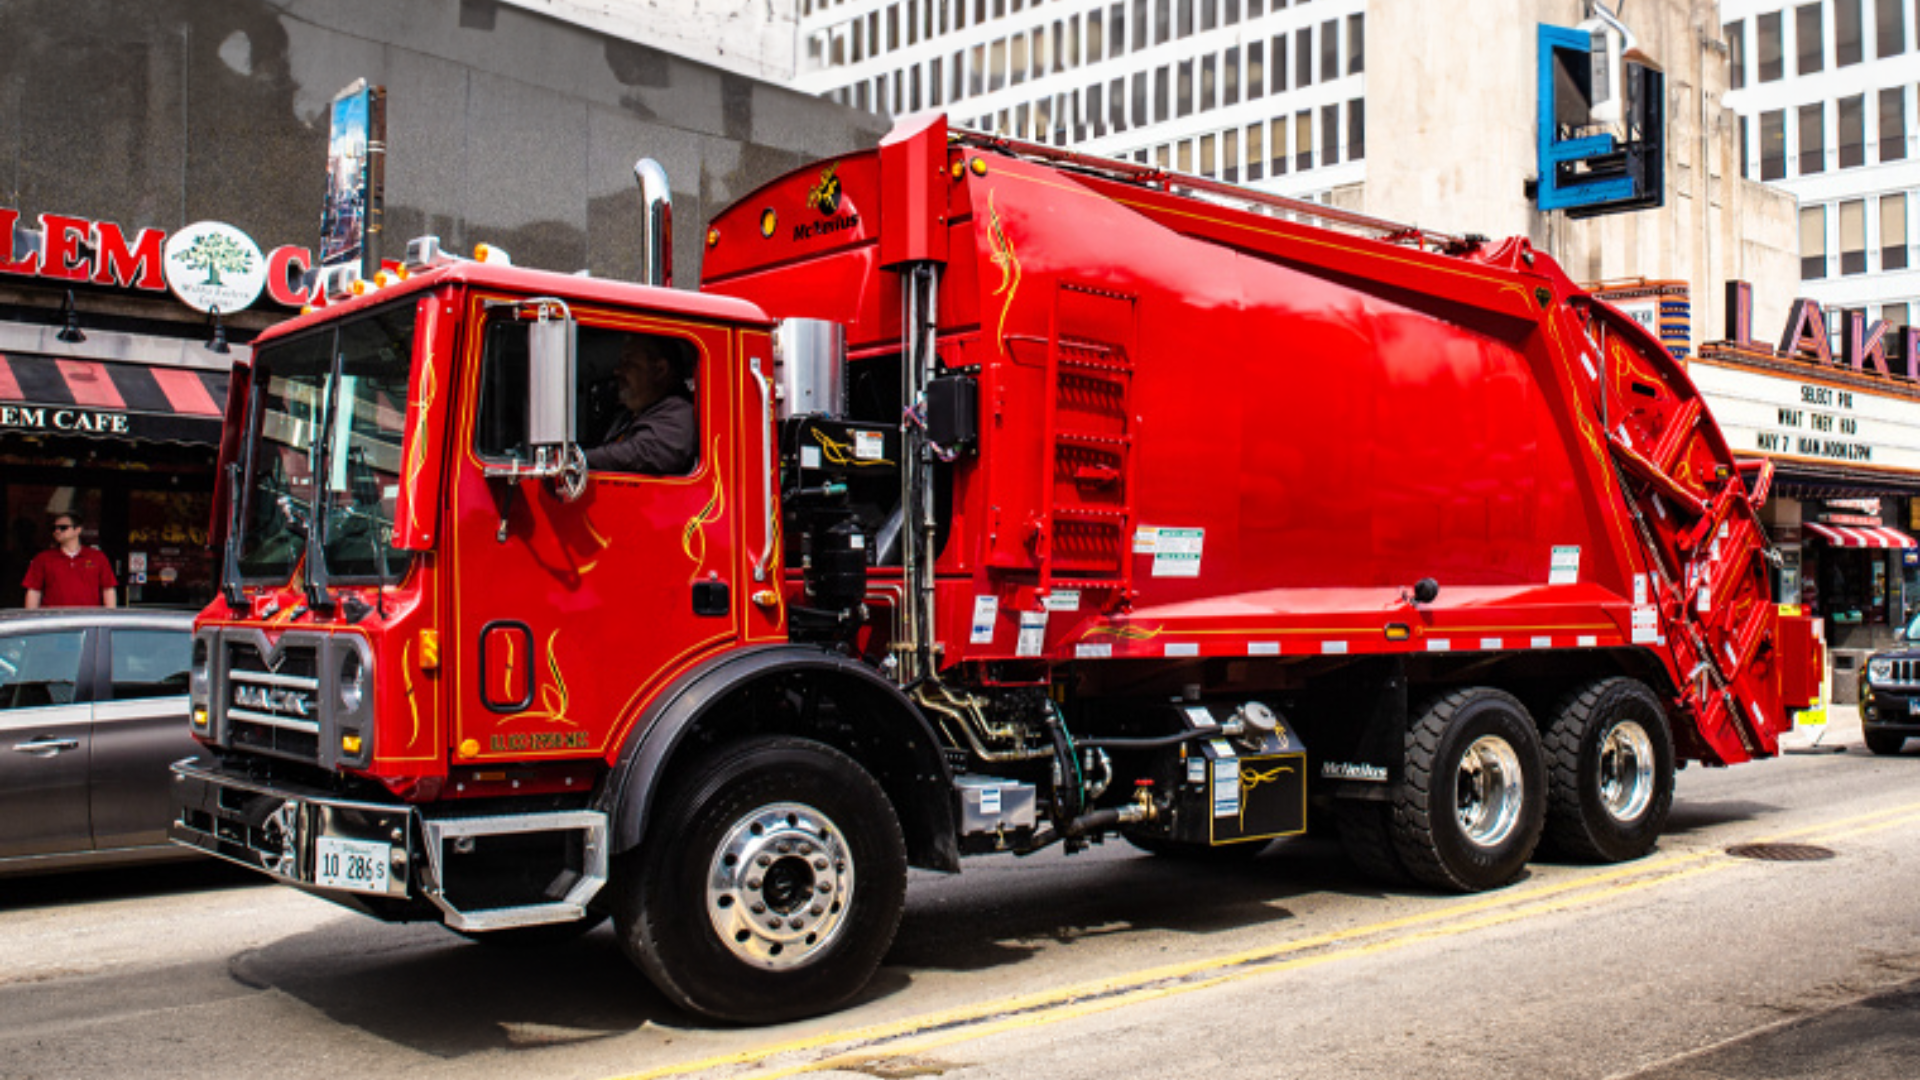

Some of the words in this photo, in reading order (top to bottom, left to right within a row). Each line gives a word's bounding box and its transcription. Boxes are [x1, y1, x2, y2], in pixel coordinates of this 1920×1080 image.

[1801, 385, 1832, 406] SELECT
[52, 410, 130, 433] CAFE
[1778, 408, 1802, 427] WHAT
[1811, 413, 1833, 432] THEY
[1840, 418, 1857, 435] HAD
[1758, 433, 1778, 452] MAY
[1783, 436, 1788, 452] 7
[234, 685, 309, 715] MACK
[323, 853, 339, 877] 10
[348, 855, 373, 881] 286
